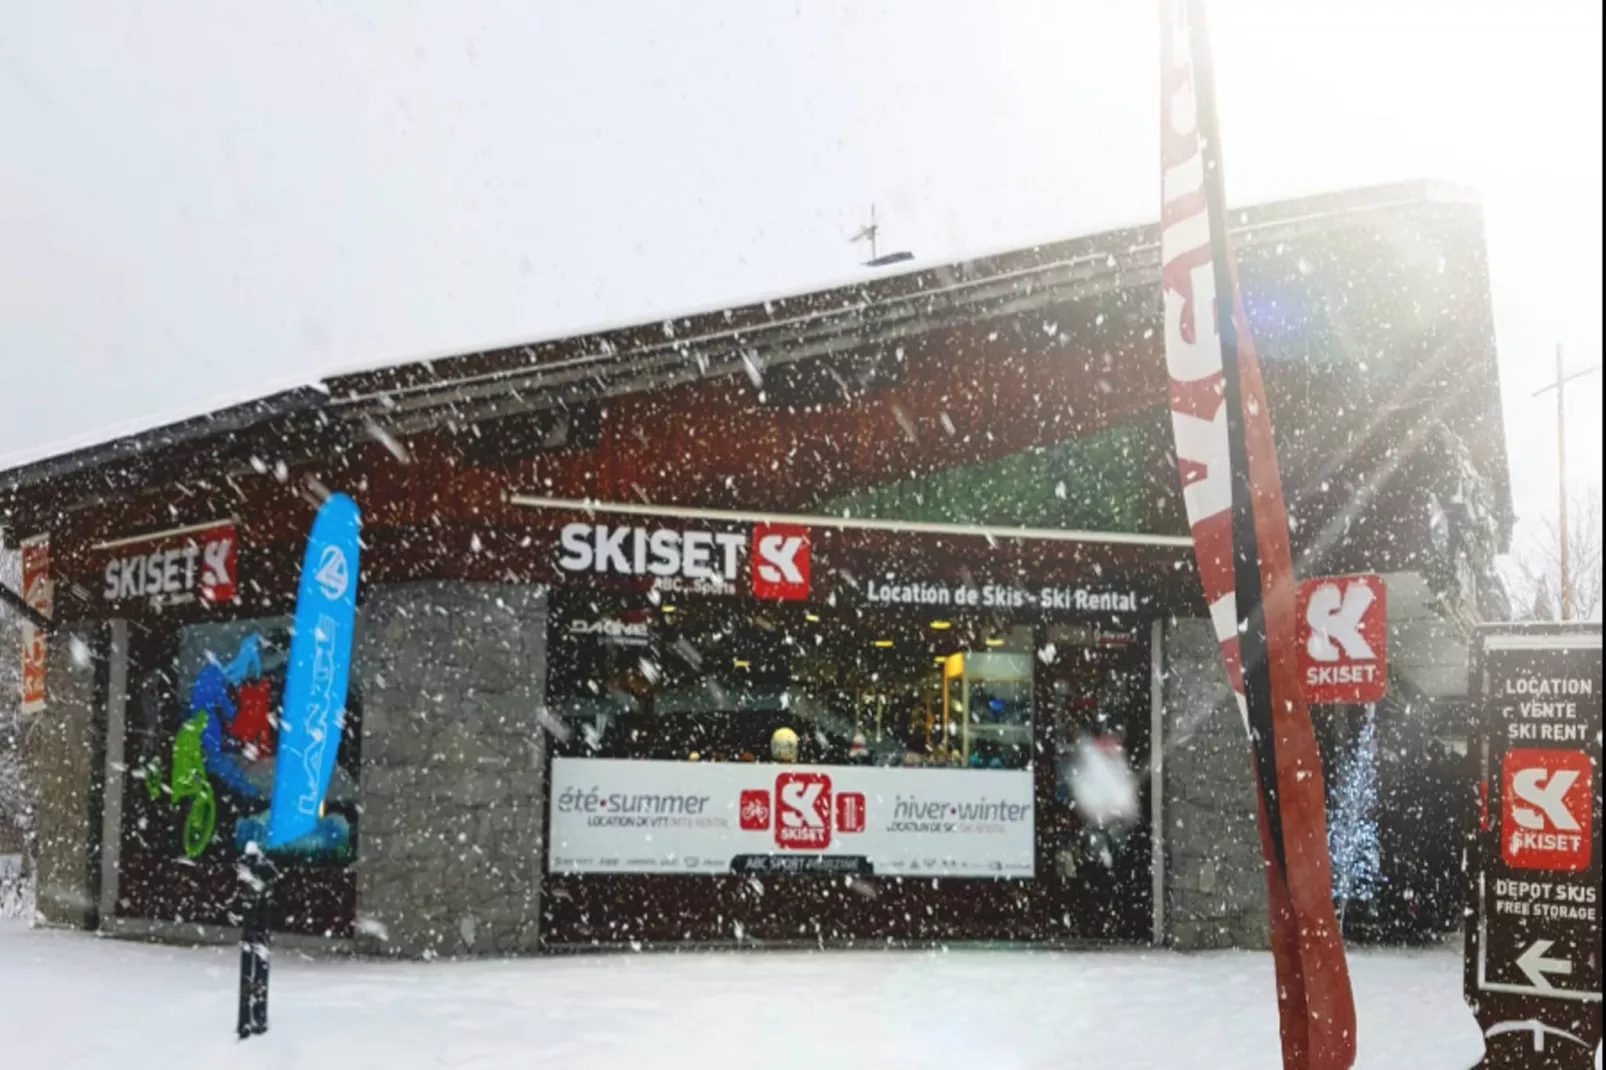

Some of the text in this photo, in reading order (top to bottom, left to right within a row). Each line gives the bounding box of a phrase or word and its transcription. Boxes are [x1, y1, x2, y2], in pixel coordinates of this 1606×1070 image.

[560, 522, 746, 579] SKISET
[103, 546, 198, 600] SKISET
[867, 580, 949, 605] Location
[954, 585, 977, 606] de
[983, 585, 1023, 607] Skis
[1041, 587, 1070, 609] Ski
[1074, 589, 1137, 611] Rental
[1306, 665, 1377, 684] SKISET
[1506, 679, 1592, 694] LOCATION
[1520, 702, 1576, 718] VENTE
[1508, 724, 1588, 740] SKI RENT
[587, 816, 634, 827] LOCATION
[781, 828, 824, 841] SKISET
[1511, 832, 1581, 852] SKISET
[1496, 880, 1596, 902] DEPOT SKIS
[1496, 901, 1596, 920] FREE STORAGE
